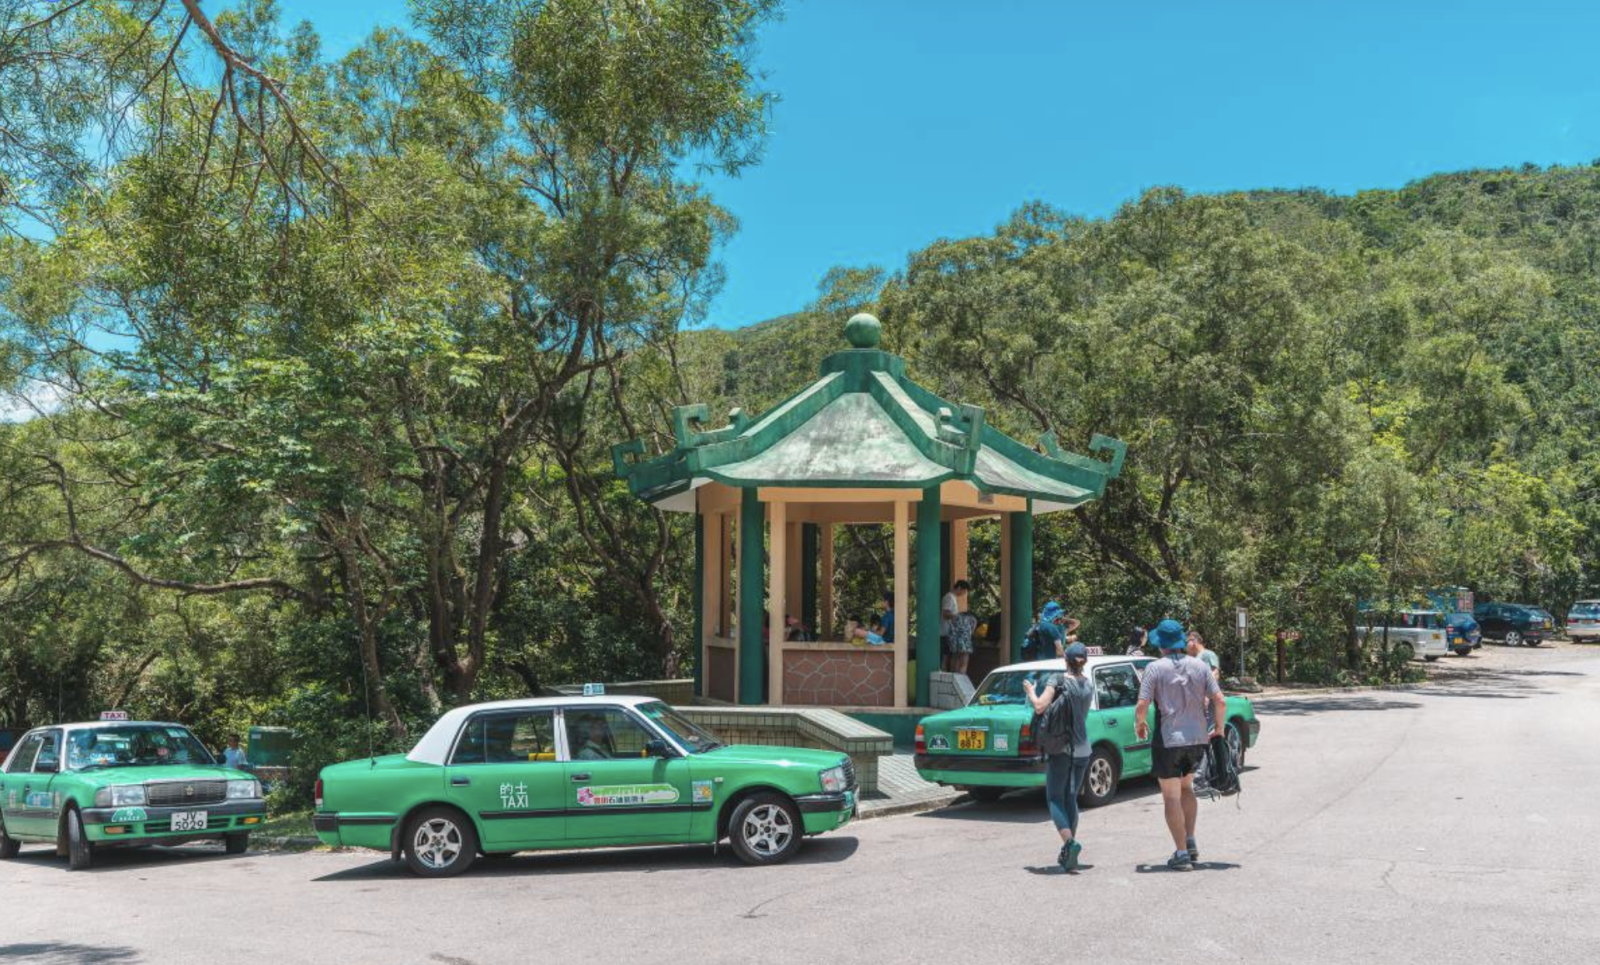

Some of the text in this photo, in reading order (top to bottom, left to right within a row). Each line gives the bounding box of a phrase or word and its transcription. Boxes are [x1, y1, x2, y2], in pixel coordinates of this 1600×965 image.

[500, 782, 528, 795] 的士
[500, 795, 528, 808] TAXI
[182, 811, 197, 821] JV
[175, 820, 204, 831] 5029
